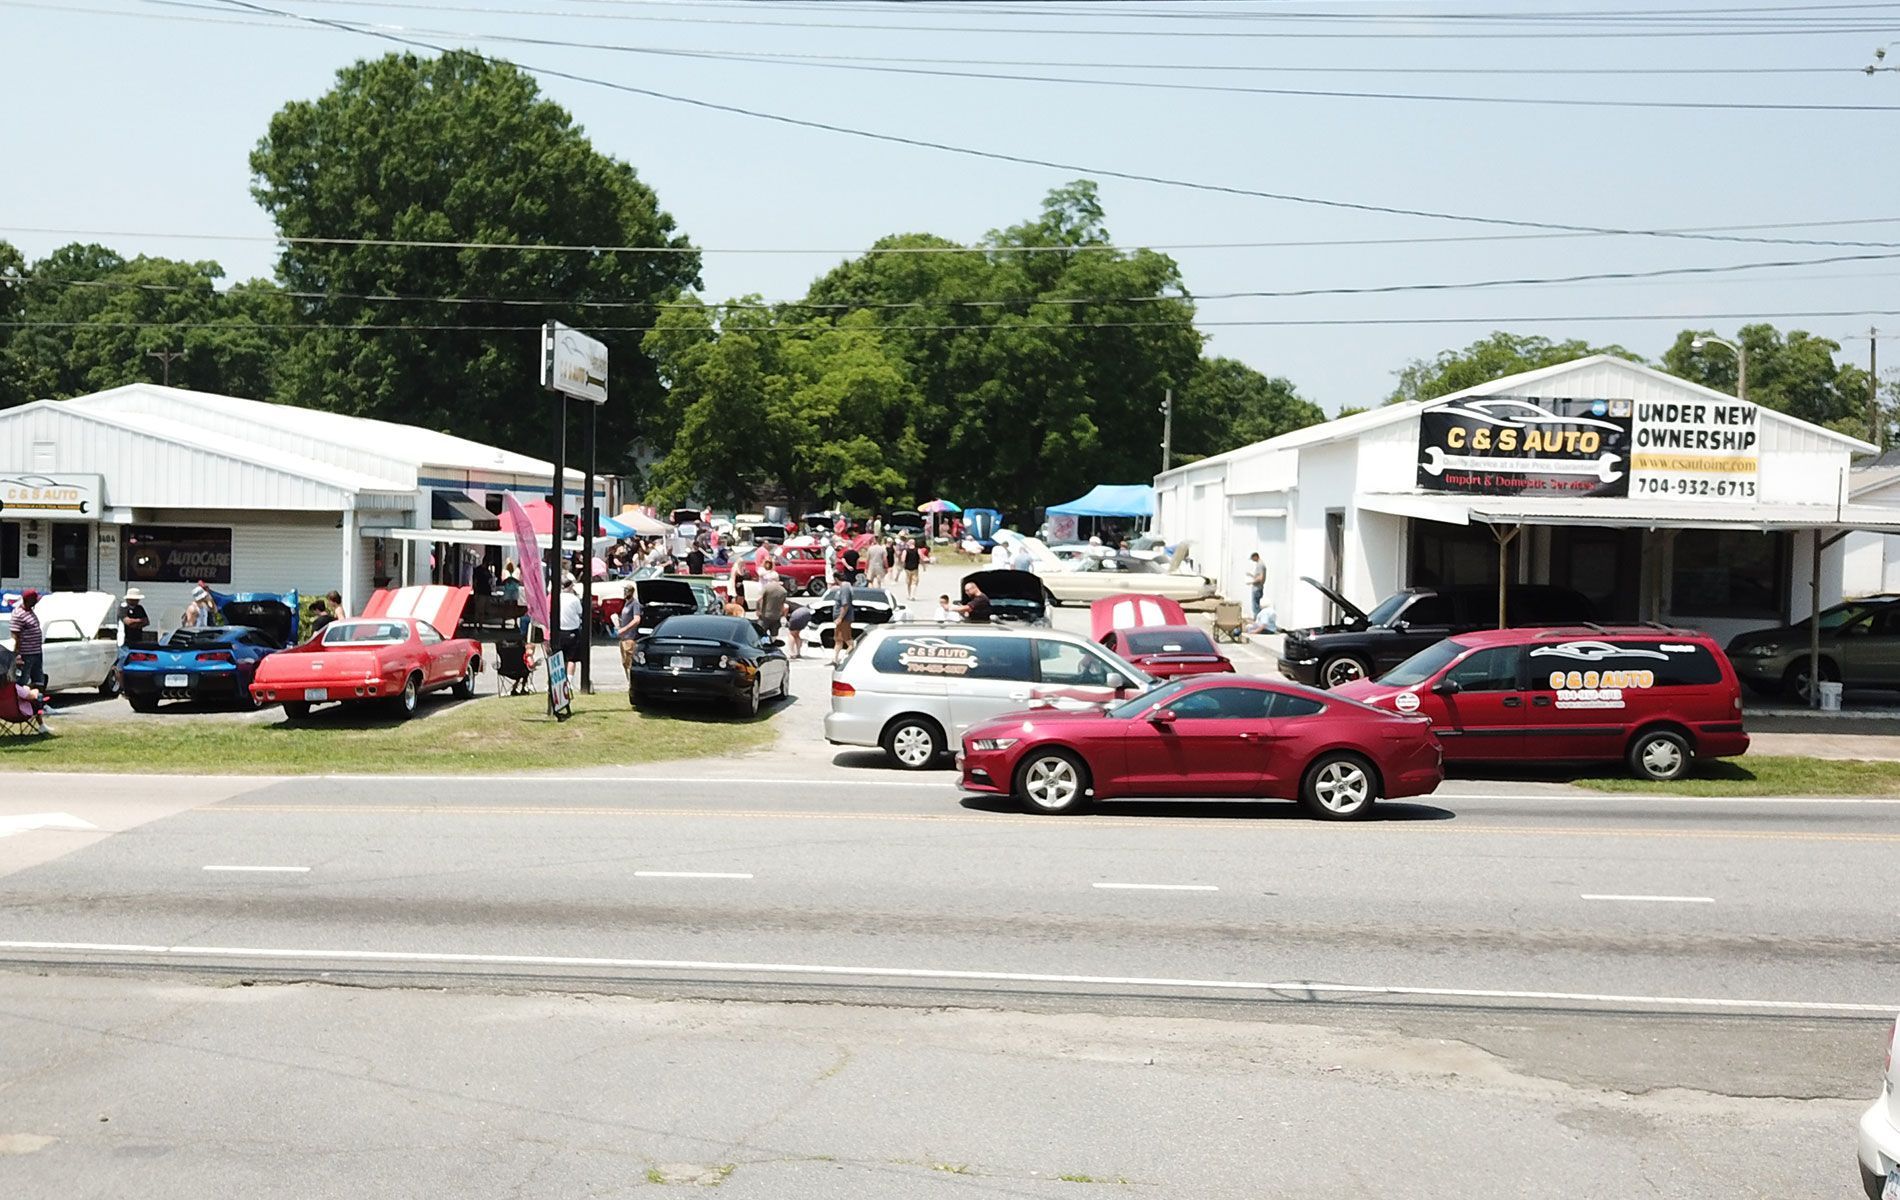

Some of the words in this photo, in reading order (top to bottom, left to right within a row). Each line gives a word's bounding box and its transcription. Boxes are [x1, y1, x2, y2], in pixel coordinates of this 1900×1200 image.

[1638, 404, 1706, 423] UNDER
[1714, 406, 1757, 425] NEW
[1448, 427, 1466, 448] C
[1472, 429, 1491, 450] &
[1498, 429, 1517, 451] S
[1523, 431, 1600, 453] AUTO
[1637, 428, 1756, 450] OWNERSHIP
[1640, 459, 1756, 471] www.csautoinc.com
[1445, 474, 1481, 486] Import
[1484, 475, 1491, 486] &
[1496, 476, 1546, 489] Domestic
[1638, 478, 1755, 496] 704-932-6713
[43, 490, 78, 499] AUTO
[179, 566, 217, 578] CENTER
[907, 647, 915, 656] C
[918, 648, 925, 656] &
[928, 648, 936, 656] S
[937, 648, 968, 657] AUTO
[1550, 671, 1566, 689] C
[1566, 671, 1583, 689] &
[1584, 671, 1599, 689] S
[1600, 670, 1654, 688] AUTO
